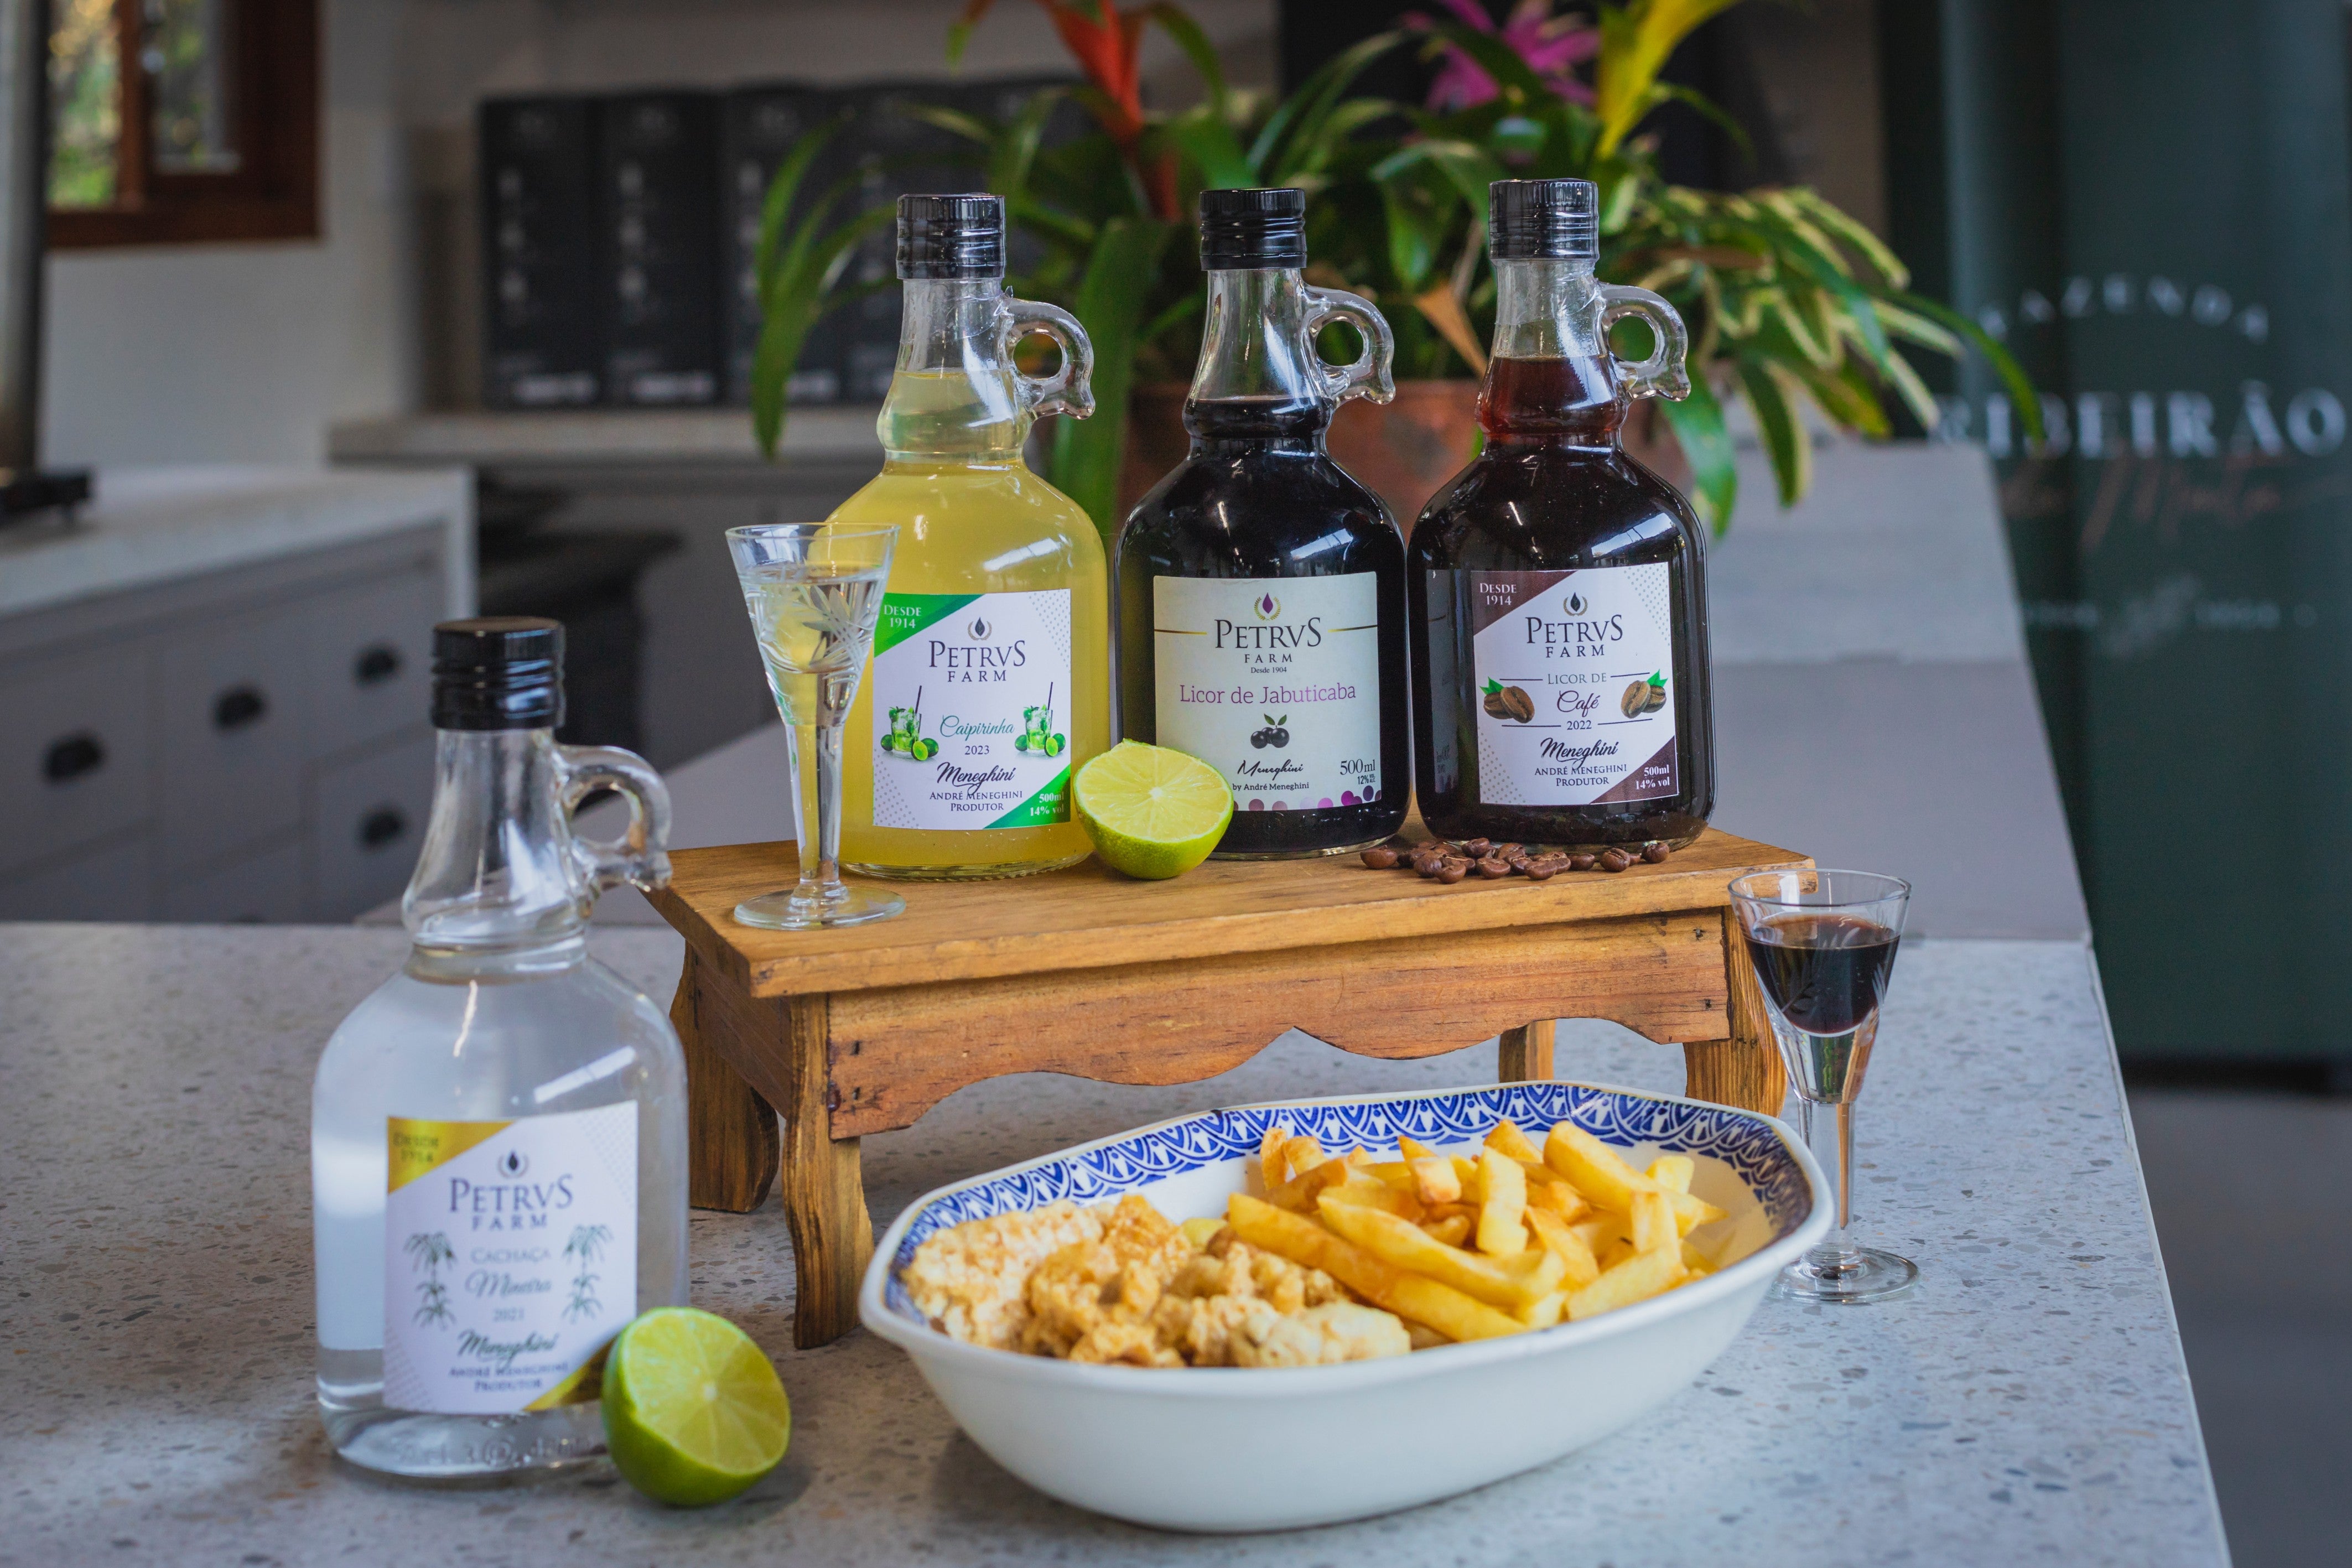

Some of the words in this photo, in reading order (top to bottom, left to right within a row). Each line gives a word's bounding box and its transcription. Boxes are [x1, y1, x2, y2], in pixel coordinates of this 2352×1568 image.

[1479, 583, 1517, 594] DESDE
[1486, 595, 1512, 605] 1914
[884, 605, 922, 617] DESDE
[889, 617, 916, 629] 1914
[1525, 614, 1623, 644] PETRVS
[1214, 617, 1322, 649] PETRVS
[928, 640, 1026, 668] PETRVS
[1545, 644, 1605, 658] FARM
[1244, 653, 1293, 663] FARM
[947, 669, 1007, 683] FARM
[1548, 673, 1587, 685] LICOR
[1591, 673, 1607, 683] DE
[1179, 684, 1225, 704] Licor
[1230, 687, 1254, 704] de
[1260, 682, 1357, 704] Jabuticaba
[1556, 690, 1599, 718] Café
[940, 714, 1015, 741] Caipirinha
[1566, 720, 1592, 730] 2022
[964, 745, 990, 755] 2023
[1540, 737, 1619, 771] Meneghini
[1237, 759, 1304, 781] Meneghini
[1339, 759, 1376, 775] 500ml
[1535, 766, 1568, 776] ANDRÉ
[1572, 764, 1628, 775] MENEGHINI
[1643, 765, 1670, 777] 500ml
[937, 761, 1015, 797] Meneghini
[1357, 775, 1369, 785] 12%
[1556, 776, 1609, 787] PRODUTOR
[1635, 779, 1656, 790] 14%
[1658, 776, 1670, 787] vol
[1232, 783, 1242, 792] by
[1269, 782, 1310, 791] Meneghini
[930, 790, 964, 801] ANDRÉ
[966, 790, 1023, 801] MENEGHINI
[1039, 791, 1064, 803] 500ml
[950, 802, 1005, 812] PRODUTOR
[1030, 806, 1050, 817] 14%
[1052, 804, 1064, 814] vol
[449, 1173, 574, 1214] PETRVS
[471, 1214, 548, 1232] FARM
